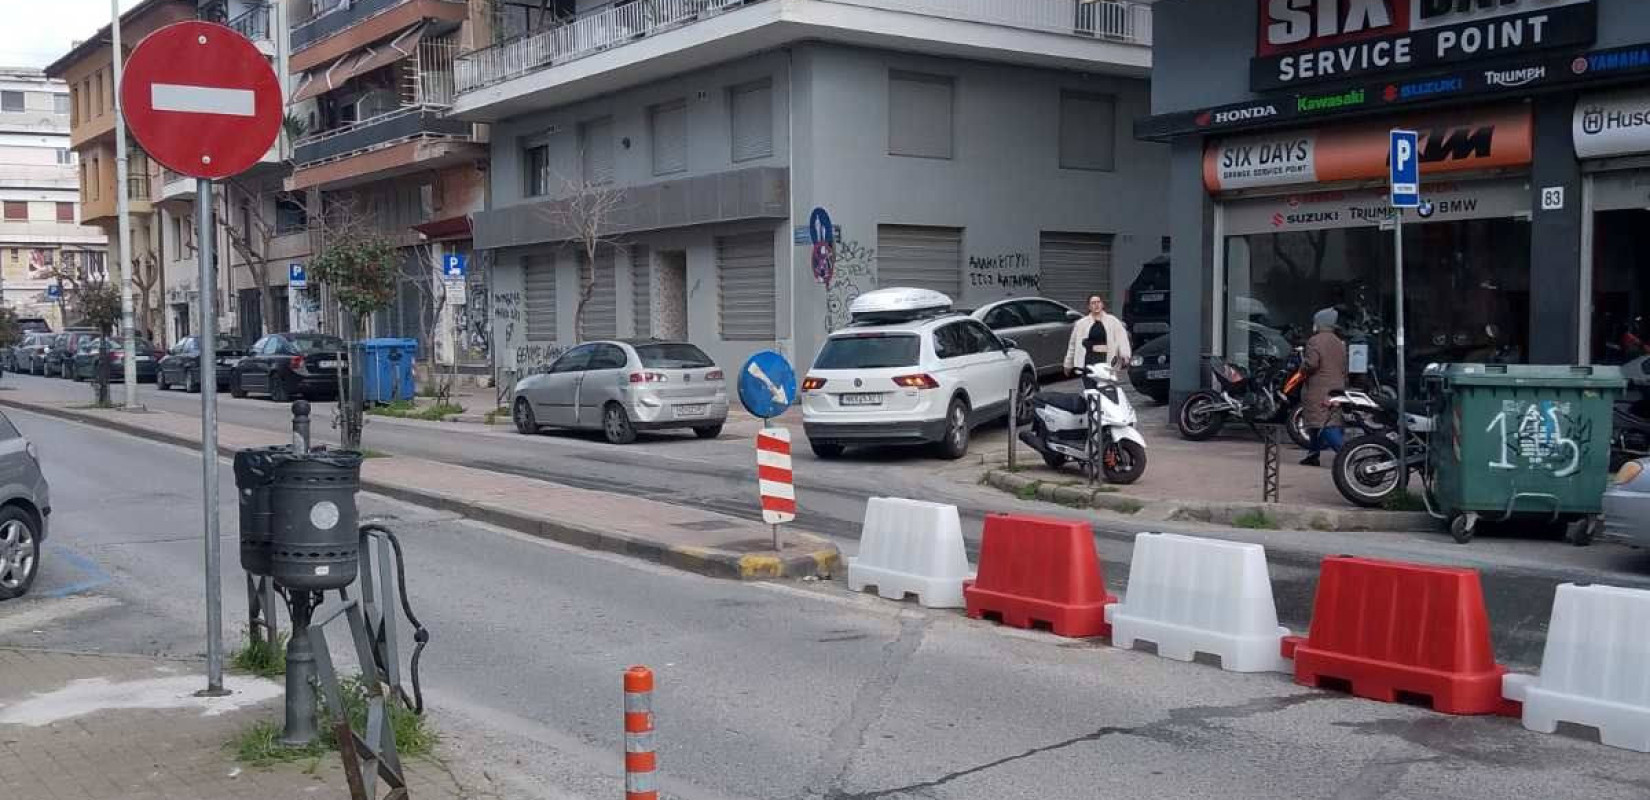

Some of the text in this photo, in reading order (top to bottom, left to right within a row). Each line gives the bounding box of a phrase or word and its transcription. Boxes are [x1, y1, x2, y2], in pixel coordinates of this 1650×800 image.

[1278, 15, 1548, 81] SERVICE POINT
[1589, 48, 1650, 71] YAMAHA
[1485, 66, 1546, 86] TRIUMPH
[1401, 78, 1463, 98] SUZUKI
[1297, 89, 1365, 111] Kawasaki
[1215, 105, 1277, 123] HONDA
[1223, 139, 1308, 168] SIX DAYS
[1397, 139, 1410, 171] P
[1439, 199, 1478, 214] BMW
[1545, 190, 1560, 206] 83
[1287, 211, 1339, 223] SUZUKI
[293, 265, 302, 276] P
[450, 257, 458, 269] P
